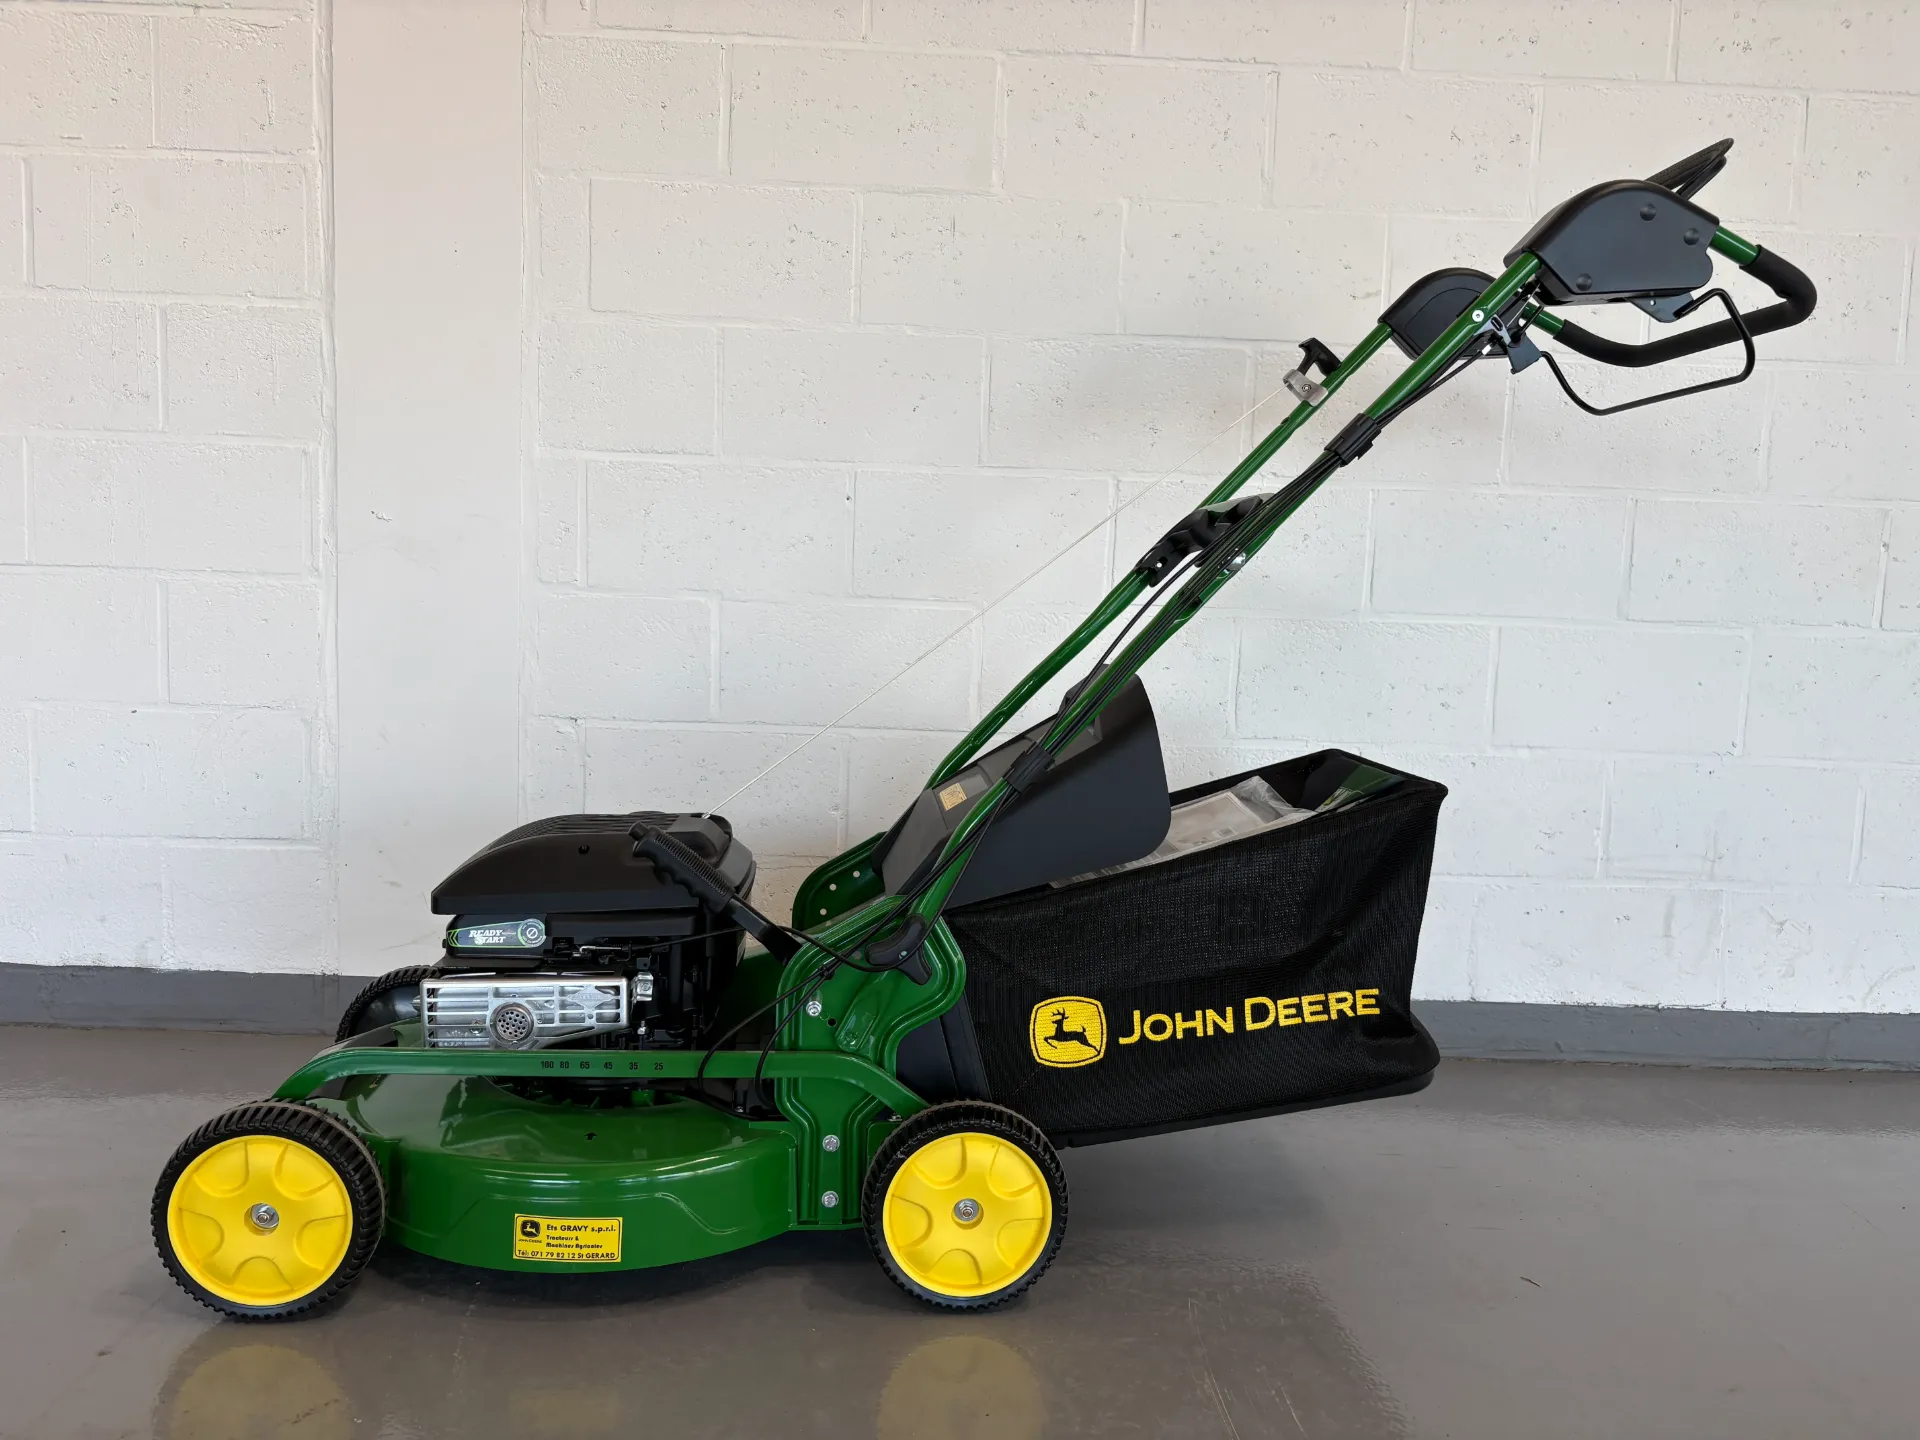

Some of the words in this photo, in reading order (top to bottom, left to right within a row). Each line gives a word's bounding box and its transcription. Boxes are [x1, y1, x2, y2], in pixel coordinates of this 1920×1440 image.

[475, 937, 505, 945] START
[1119, 1007, 1234, 1044] JOHN
[1245, 989, 1380, 1030] DEERE
[541, 1061, 554, 1069] 100
[560, 1061, 569, 1069] 80
[580, 1061, 590, 1069] 65
[604, 1062, 613, 1070] 45
[629, 1062, 638, 1070] 35
[654, 1062, 663, 1070] 25
